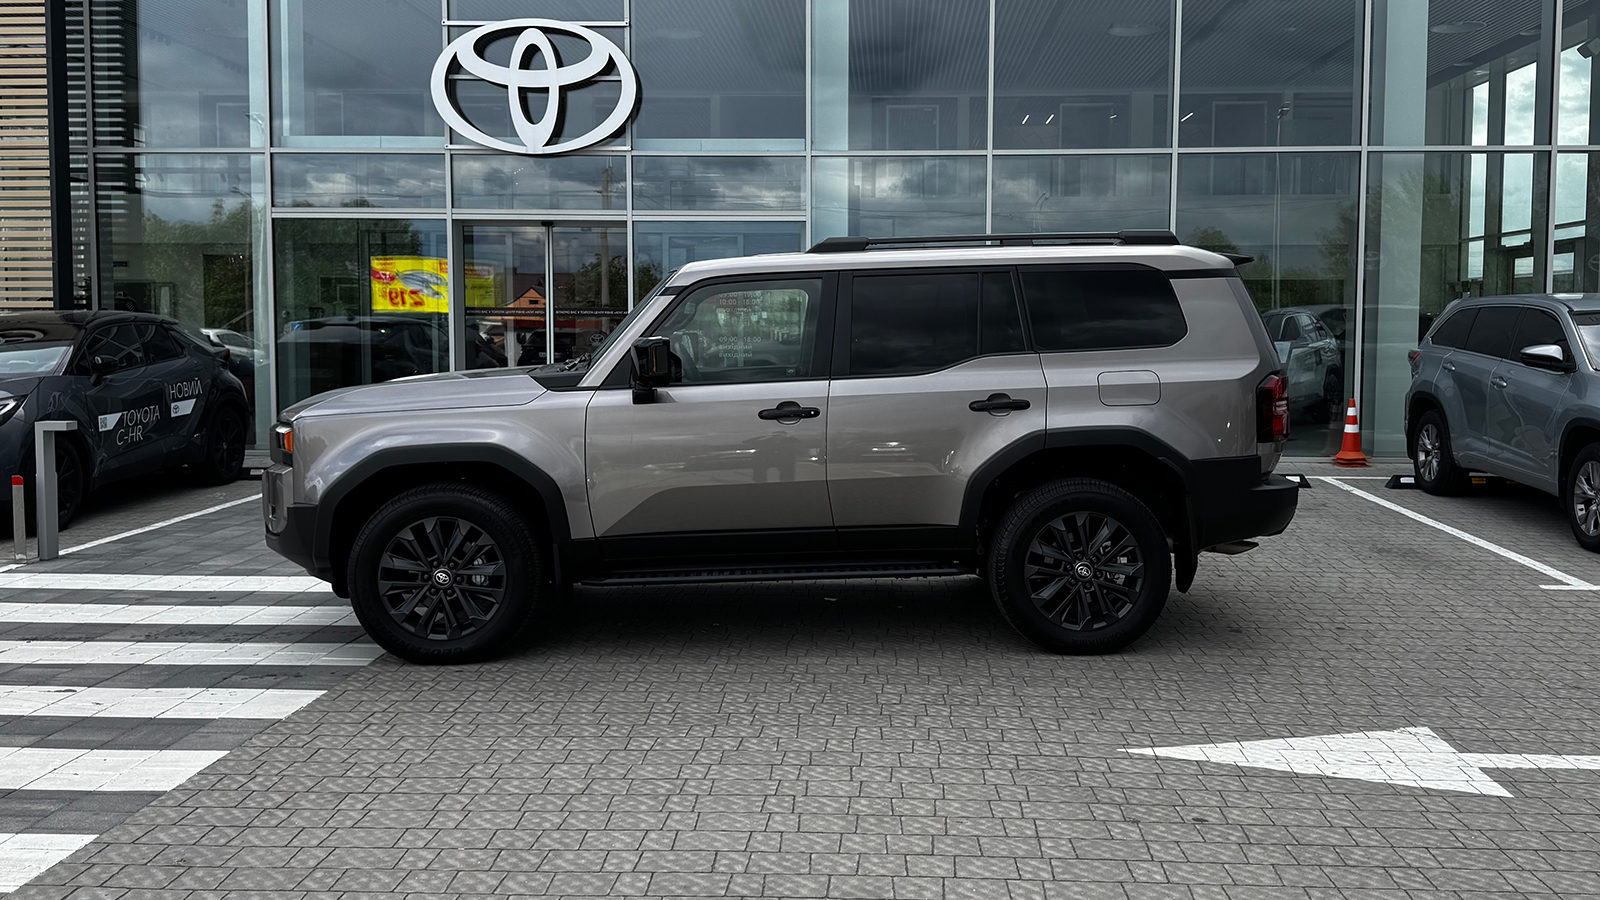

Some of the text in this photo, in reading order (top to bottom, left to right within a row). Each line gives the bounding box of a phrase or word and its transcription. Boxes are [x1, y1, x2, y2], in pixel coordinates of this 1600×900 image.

[718, 343, 753, 351] вихідний
[718, 351, 753, 359] вихідний
[169, 377, 203, 400] НОВИЙ
[122, 405, 161, 427] TOYOTA
[116, 425, 144, 446] C-HR
[478, 510, 520, 559] YOKOHAMA
[1071, 628, 1128, 647] YOKOHAMA
